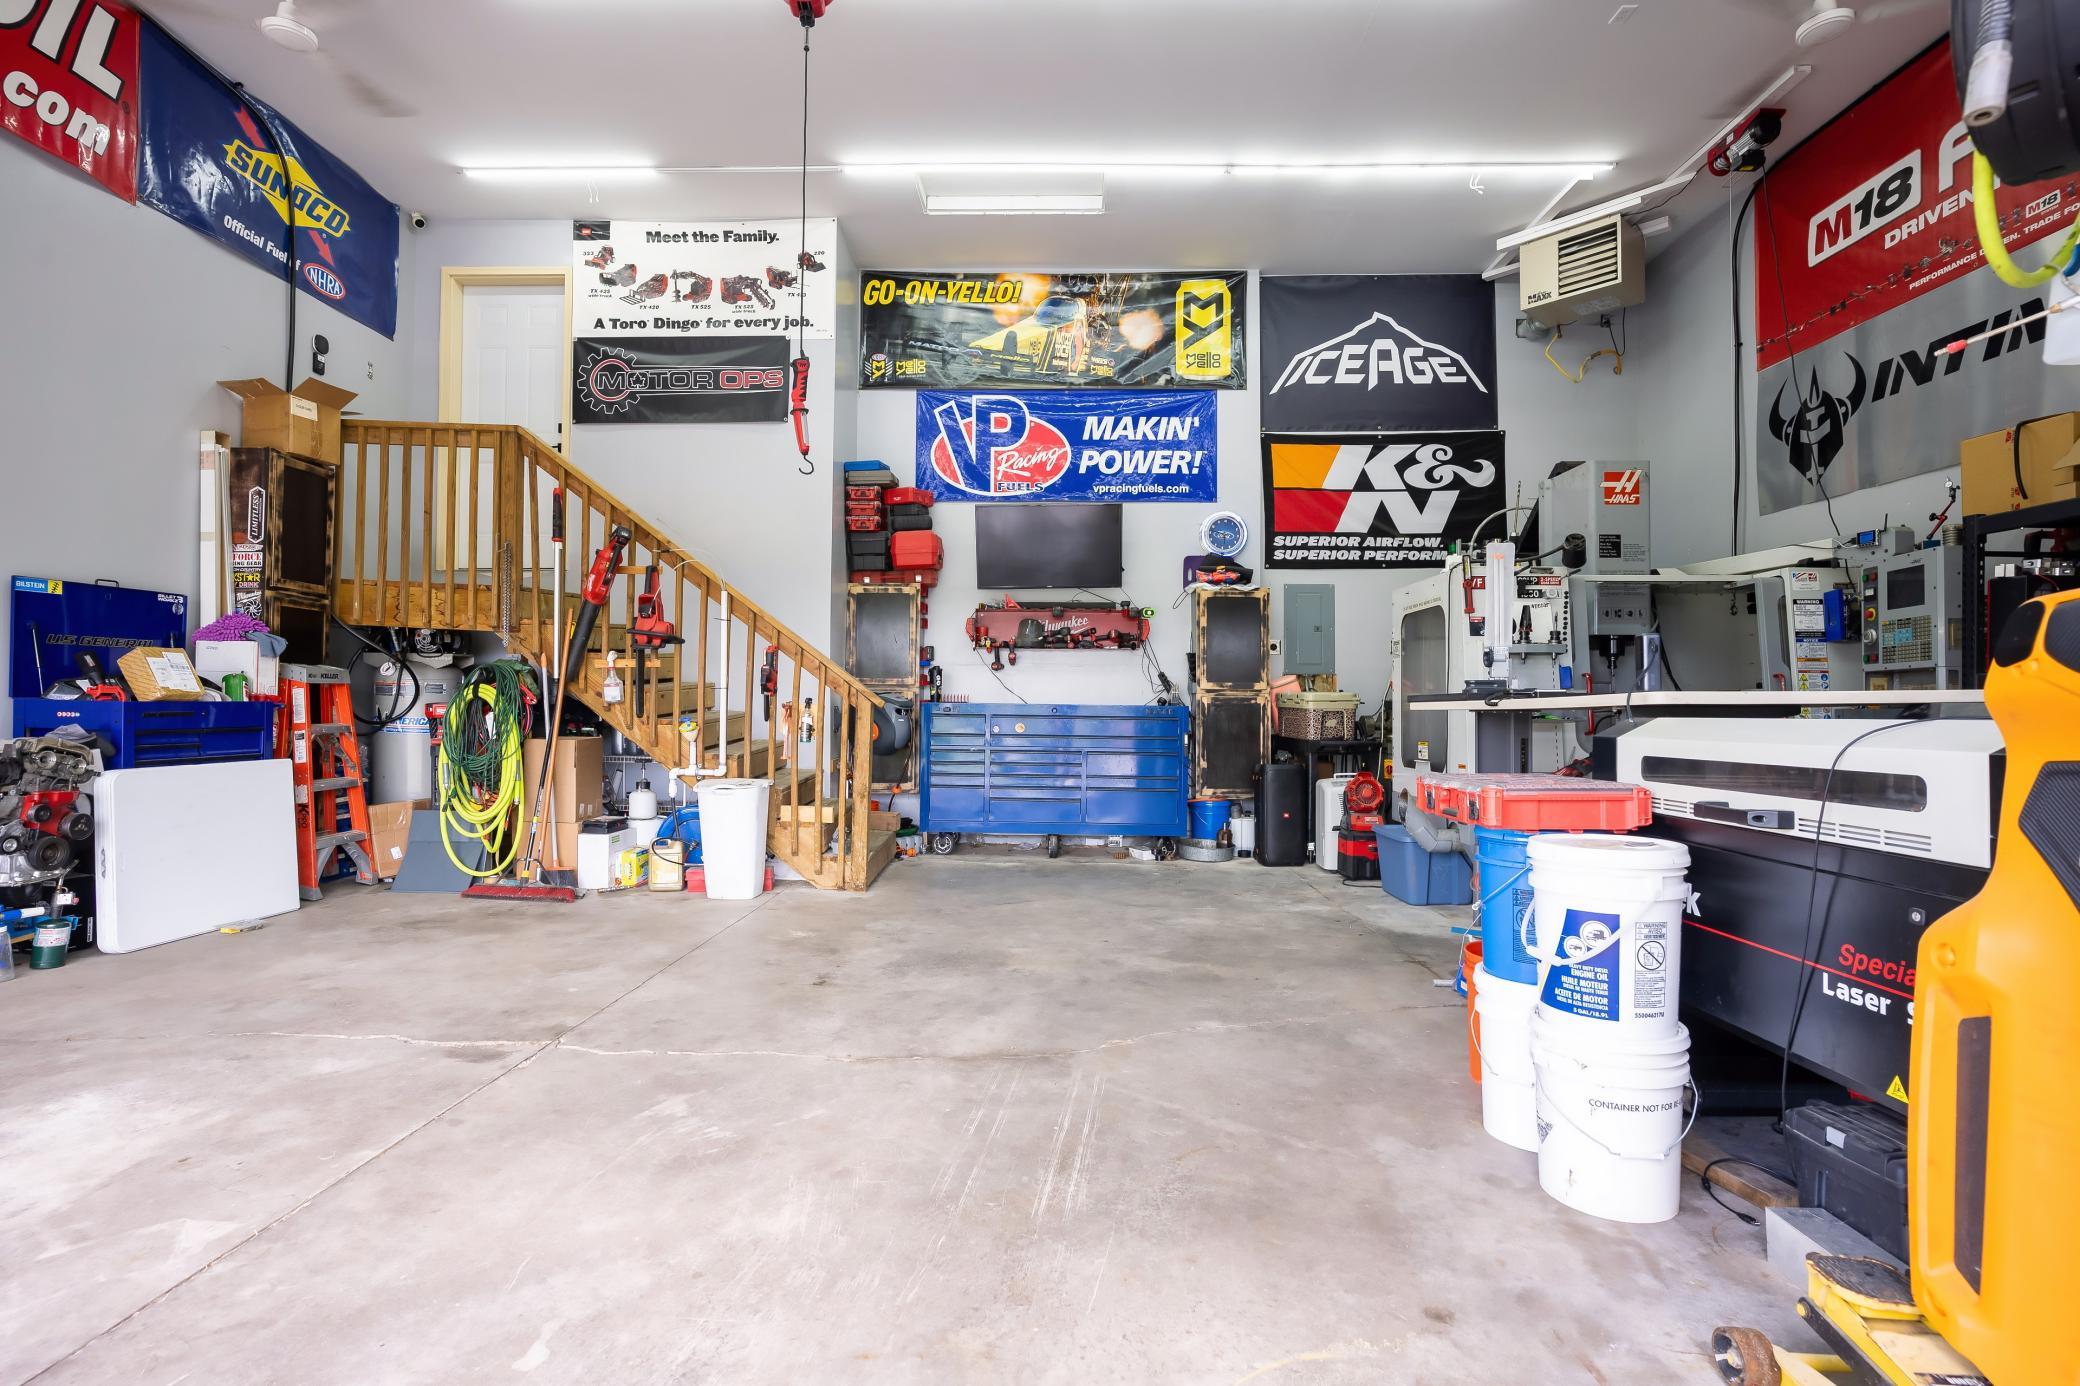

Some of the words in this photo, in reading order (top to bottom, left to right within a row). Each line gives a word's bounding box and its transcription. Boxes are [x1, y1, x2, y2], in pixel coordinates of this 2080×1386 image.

[3, 69, 112, 158] com
[230, 144, 348, 234] SUNOCO
[1814, 165, 1915, 258] M18
[2028, 192, 2059, 215] M18
[223, 215, 264, 249] Official
[265, 240, 288, 265] Fuel
[645, 230, 689, 243] Meet
[691, 230, 720, 243] the
[723, 229, 780, 245] Family.
[1909, 251, 1978, 291] PERFORMANCE
[2023, 211, 2062, 234] TRADE
[308, 267, 341, 296] NHRA
[863, 279, 1024, 306] GO-ON-YELLO!
[593, 318, 606, 330] A
[608, 317, 648, 330] Toro
[652, 316, 700, 332] Dingo
[706, 317, 731, 329] for
[734, 317, 782, 331] every
[784, 314, 815, 331] job.
[1284, 337, 1468, 392] ICEAGE
[597, 370, 714, 390] MOTOR
[719, 370, 784, 389] OPS
[1082, 415, 1201, 441] MAKIN'
[933, 394, 1031, 496] VP
[996, 445, 1068, 480] Racing
[1078, 449, 1203, 475] POWER!
[996, 481, 1045, 493] FUELS
[1092, 483, 1190, 496] vpracingfuels.com
[1604, 493, 1640, 504] HAAS
[251, 494, 260, 536] LIMITLESS
[1273, 535, 1359, 549] SUPERIOR
[1362, 536, 1445, 549] AIRFLOW.
[1273, 549, 1359, 562] SUPERIOR
[15, 580, 45, 589] BILSTEIN
[1561, 974, 1579, 986] HUILE
[1580, 980, 1609, 991] MOTEUR
[1570, 968, 1596, 980] ENGINE
[1596, 972, 1609, 982] OIL
[1554, 986, 1573, 999] ACEITE
[1573, 992, 1582, 1001] DE
[1582, 994, 1609, 1006] MOTOR
[1822, 971, 1892, 1016] Laser
[1588, 1098, 1641, 1113] CONTAINER
[1642, 1104, 1660, 1113] NOT
[1660, 1102, 1673, 1112] FOR
